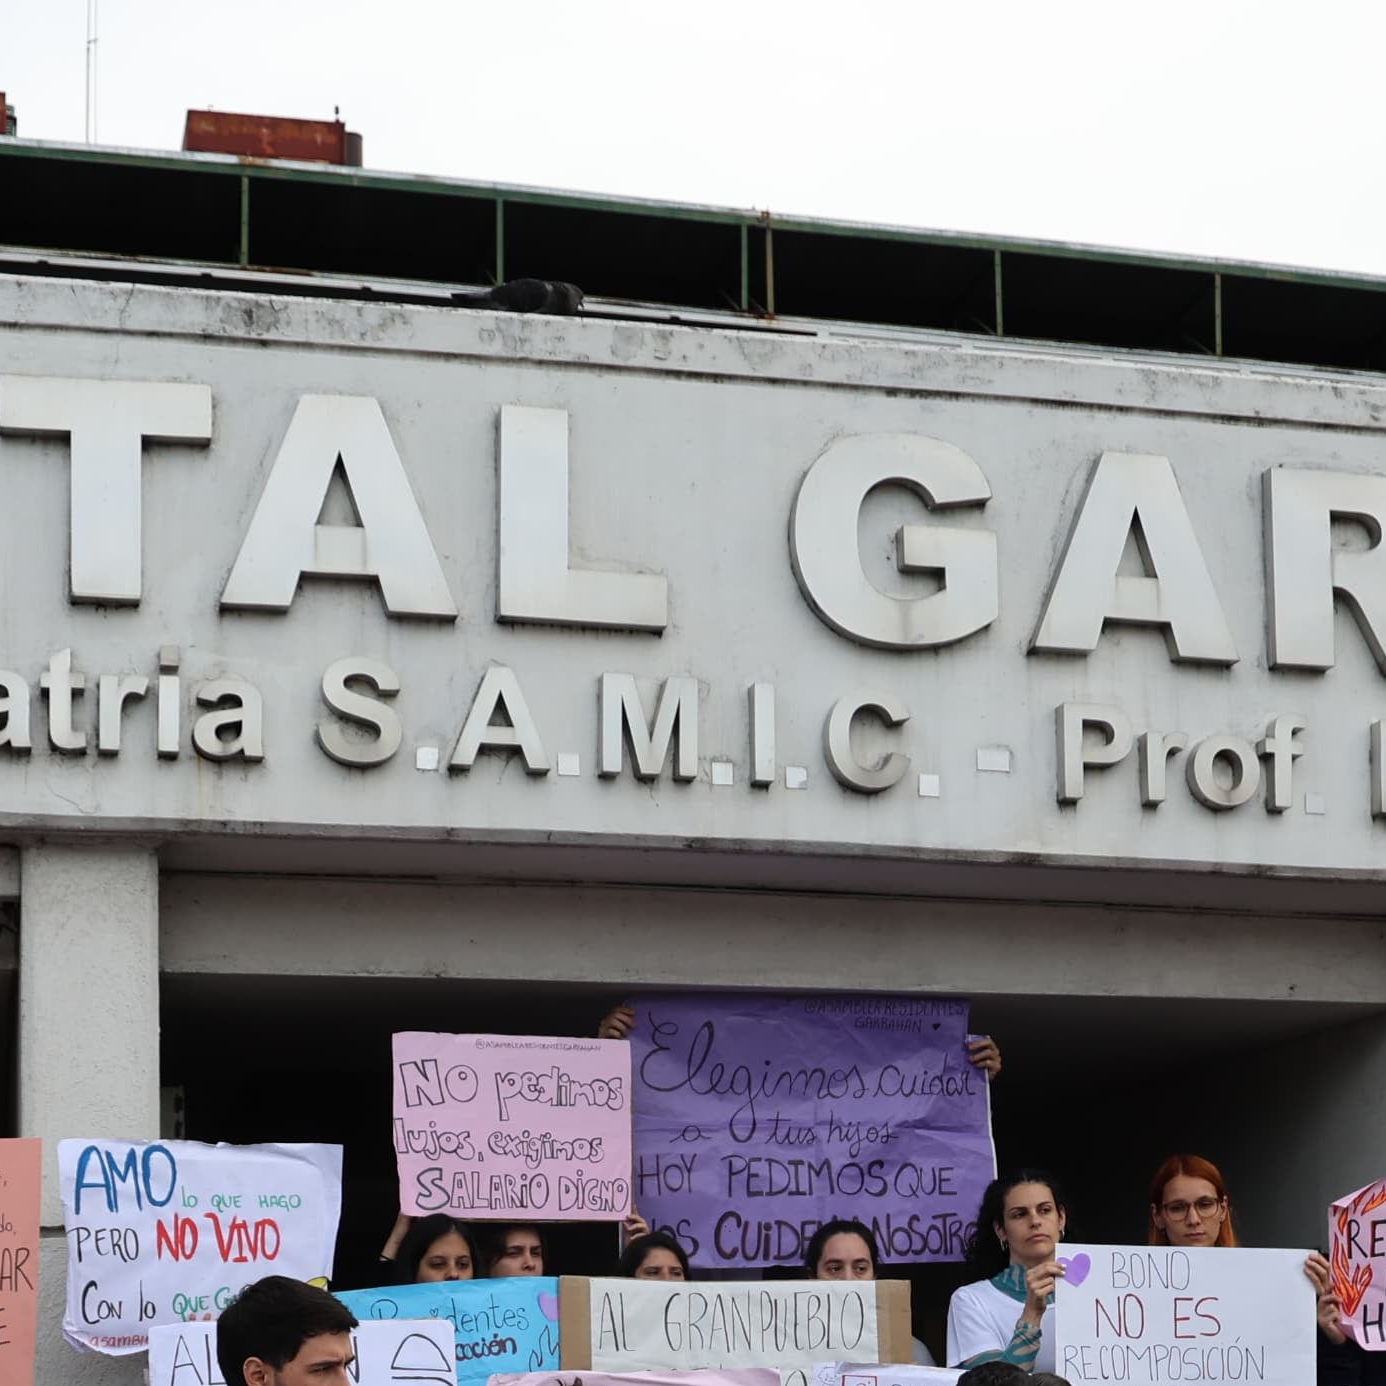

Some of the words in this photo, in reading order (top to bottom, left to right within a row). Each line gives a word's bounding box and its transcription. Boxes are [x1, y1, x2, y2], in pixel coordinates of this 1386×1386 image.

[315, 656, 940, 798] S.A.M.I.C.
[1056, 701, 1327, 817] Prof.
[399, 1058, 480, 1108] NO
[495, 1065, 624, 1121] pedimos
[640, 1010, 869, 1143] Elegimos
[487, 1128, 605, 1169] exigimos
[765, 1111, 815, 1145] tus
[826, 1110, 899, 1158] hijos
[73, 1144, 178, 1216] AMO
[210, 1193, 243, 1213] QUE
[257, 1193, 302, 1213] HAGO
[639, 1153, 698, 1197] HOY
[720, 1153, 888, 1198] PEDIMOS
[893, 1167, 958, 1199] QUE
[67, 1226, 140, 1263] PERO
[156, 1212, 199, 1262] NO
[204, 1212, 281, 1263] VIVO
[1111, 1250, 1191, 1291] BONO
[172, 1292, 210, 1322] QUE
[598, 1290, 637, 1353] AL
[663, 1291, 752, 1354] GRAN
[760, 1289, 865, 1354] PUEBLO
[1095, 1299, 1145, 1342] NO
[1174, 1296, 1222, 1341] ES
[1064, 1335, 1266, 1382] RECOMPOSICIÓN
